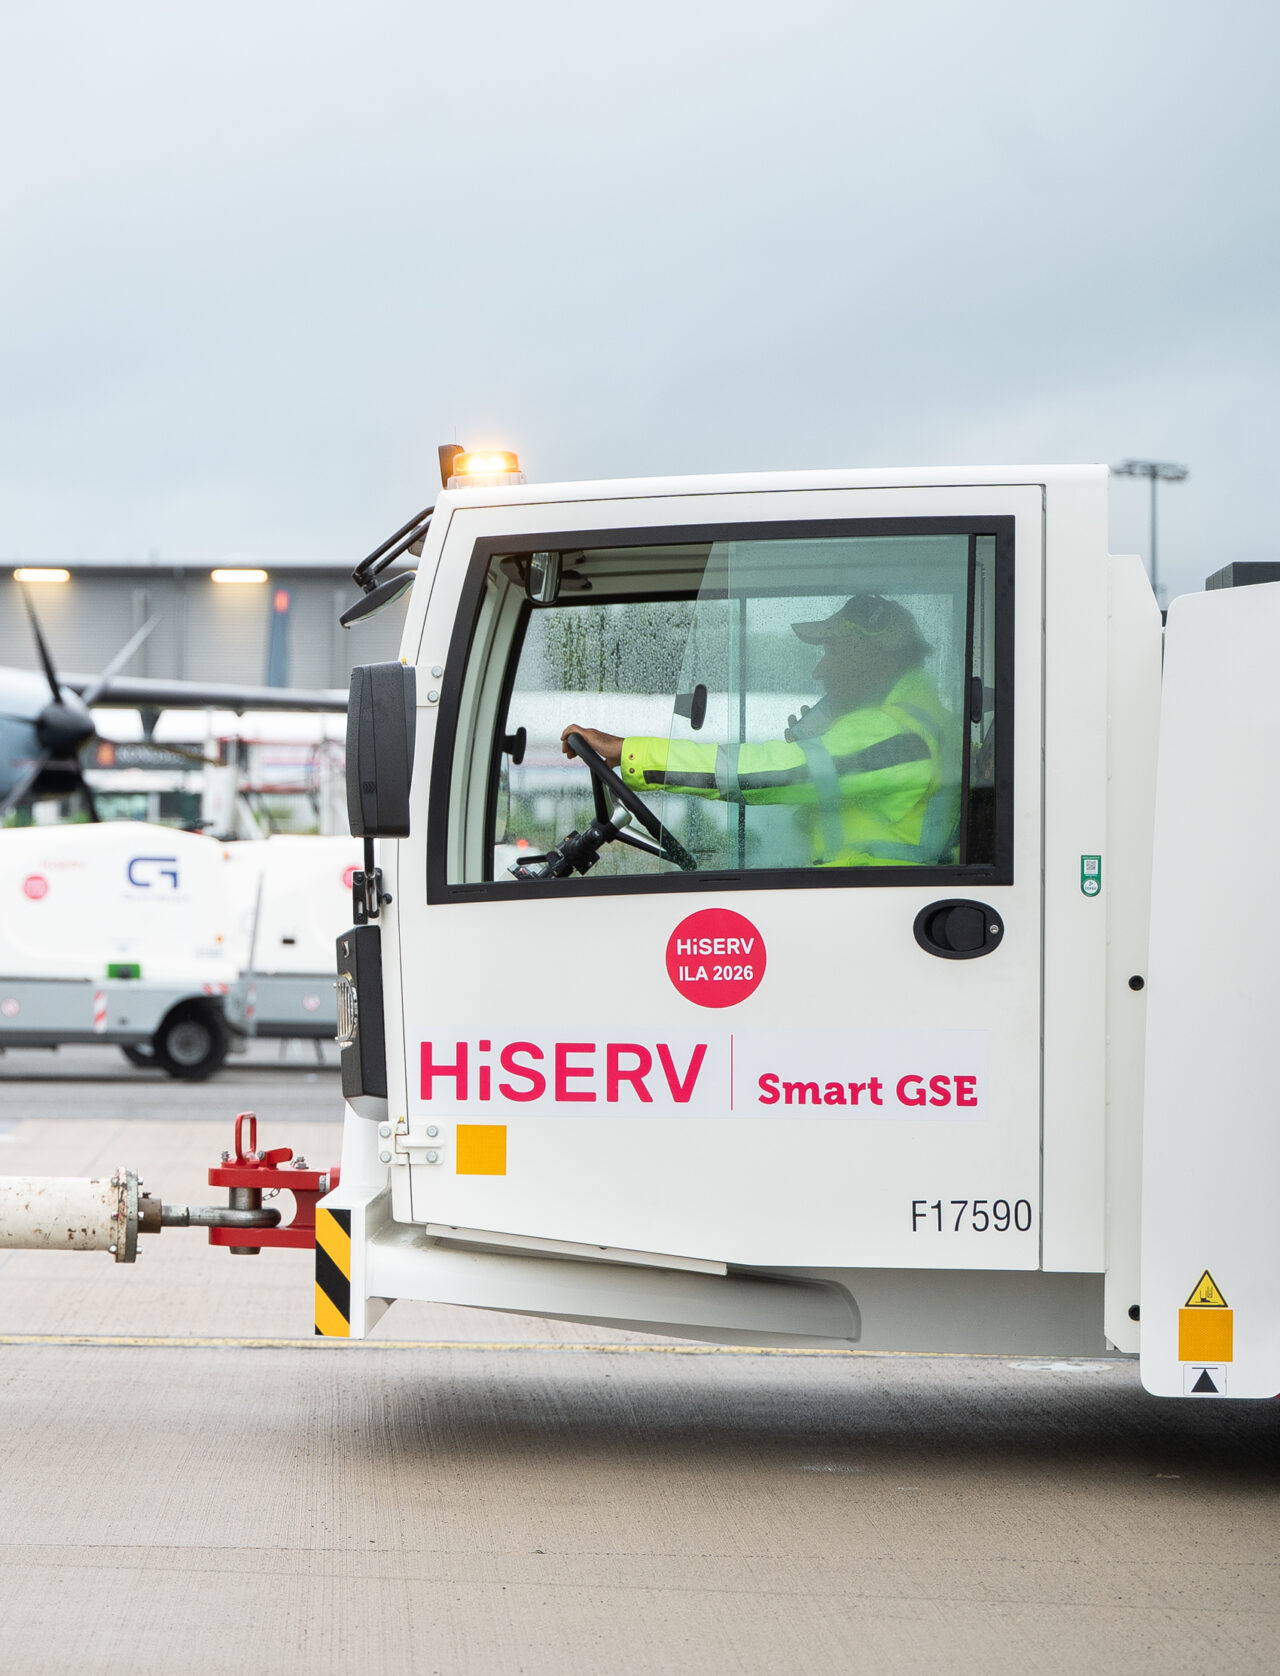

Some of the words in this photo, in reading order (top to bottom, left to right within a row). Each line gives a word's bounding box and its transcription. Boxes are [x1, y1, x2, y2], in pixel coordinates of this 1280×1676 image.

[676, 937, 755, 956] HiSERV
[679, 965, 709, 982] ILA
[712, 964, 754, 981] 2026
[420, 1040, 708, 1104] HiSERV
[758, 1073, 884, 1106] Smart
[896, 1074, 978, 1107] GSE
[911, 1199, 1032, 1232] F17590
